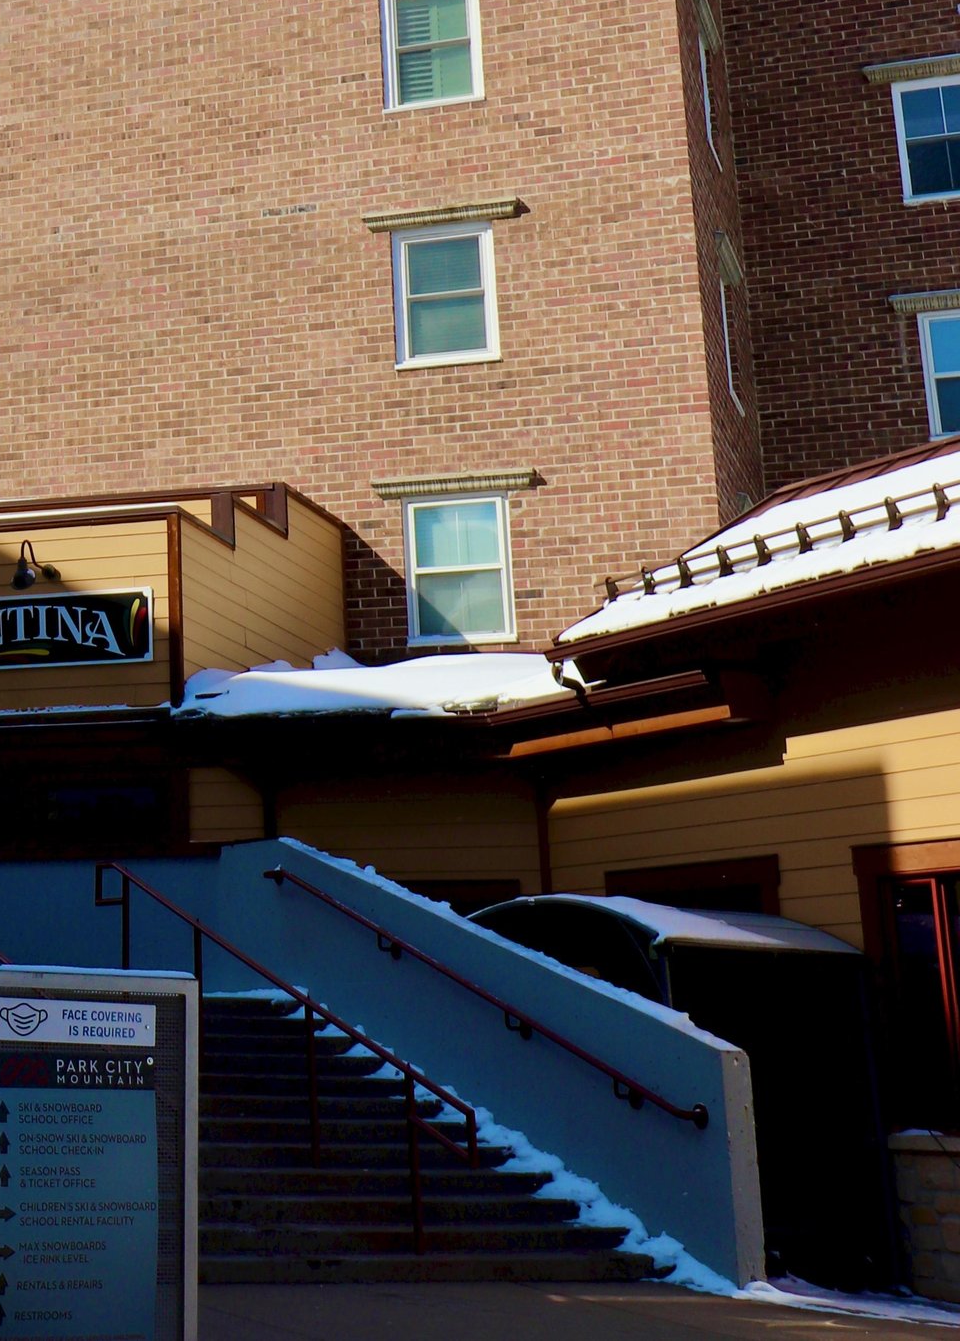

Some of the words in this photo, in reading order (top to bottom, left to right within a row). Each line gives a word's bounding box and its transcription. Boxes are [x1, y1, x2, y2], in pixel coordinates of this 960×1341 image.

[62, 1009, 88, 1020] FACE
[91, 1011, 142, 1023] COVERING
[69, 1025, 79, 1036] IS
[82, 1026, 135, 1038] REQUIRED
[56, 1059, 98, 1073] PARK
[105, 1061, 143, 1075] CITY
[56, 1074, 144, 1085] MOUNTAIN
[18, 1102, 32, 1112] SKI
[34, 1104, 41, 1112] &
[43, 1103, 102, 1113] SNOWBOARD
[19, 1115, 58, 1124] SCHOOL
[60, 1115, 93, 1125] OFFICE
[19, 1133, 65, 1143] ON-SNOW
[66, 1133, 80, 1143] SKI
[89, 1134, 147, 1144] SNOWBOARD
[19, 1145, 59, 1155] SCHOOL
[61, 1146, 104, 1155] CHECK-IN
[19, 1166, 57, 1176] SEASON
[59, 1166, 81, 1176] PASS
[19, 1179, 26, 1188] &
[28, 1178, 60, 1188] TICKET
[62, 1179, 96, 1188] OFFICE
[75, 1202, 90, 1211] SKI
[90, 1203, 97, 1211] &
[98, 1202, 157, 1211] SNOWBOARD
[19, 1217, 59, 1226] SCHOOL
[61, 1217, 95, 1226] RENTAL
[96, 1216, 135, 1226] FACILITY
[18, 1242, 40, 1251] MAX
[41, 1241, 107, 1251] SNOWBOARDS
[23, 1255, 38, 1264] ICE
[40, 1254, 60, 1264] RINK
[62, 1254, 89, 1263] LEVEL
[16, 1280, 57, 1291] RENTALS
[59, 1281, 66, 1290] &
[67, 1280, 103, 1289] REPAIRS
[14, 1310, 73, 1320] RESTROOMS
